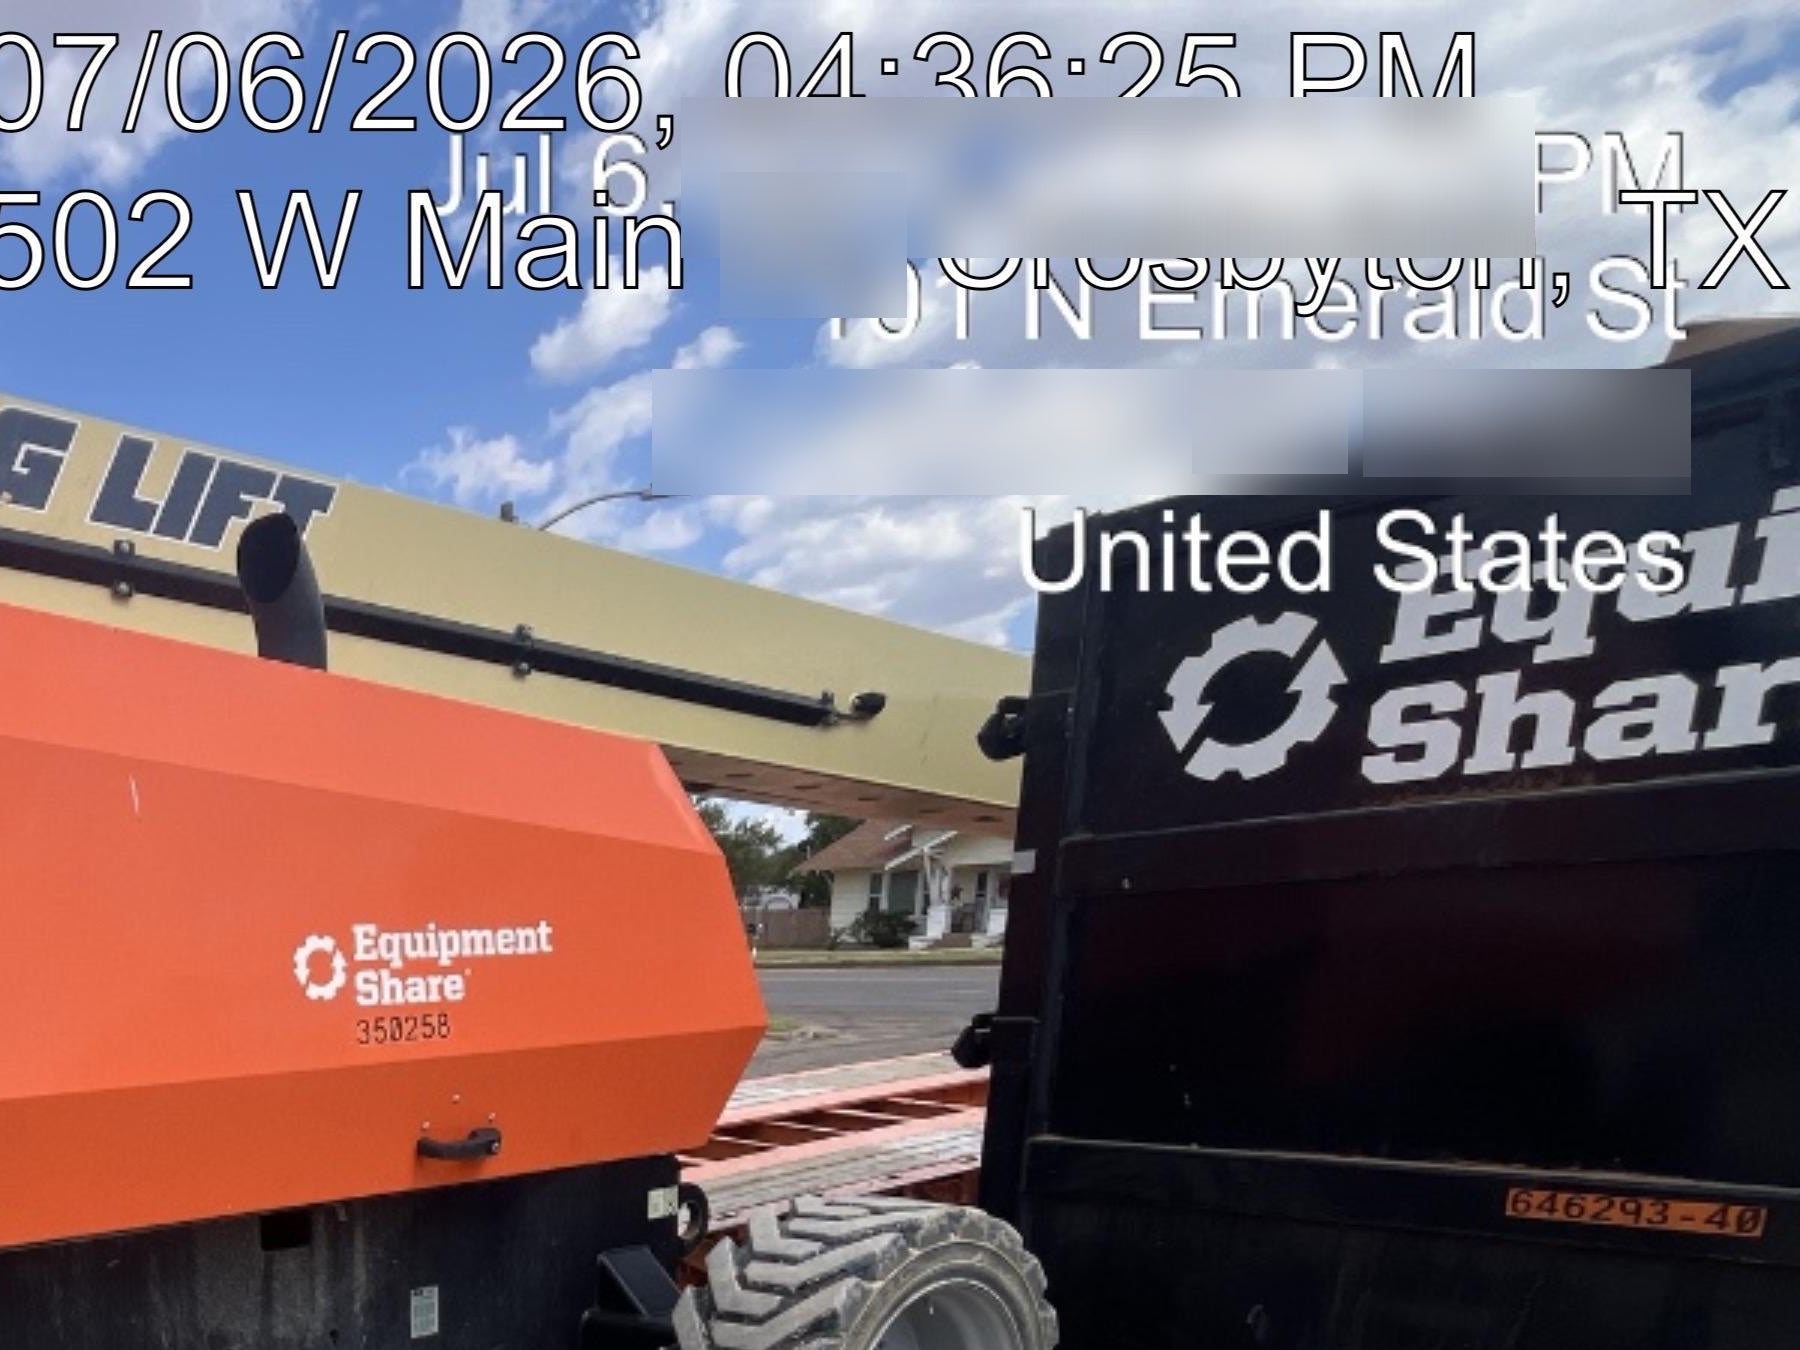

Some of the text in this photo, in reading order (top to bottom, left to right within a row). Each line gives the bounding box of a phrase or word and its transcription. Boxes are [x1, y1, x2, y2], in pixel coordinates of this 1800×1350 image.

[352, 920, 553, 968] Equipment
[354, 968, 466, 1006] Share
[356, 1013, 451, 1045] 350258
[1510, 1191, 1761, 1234] 646293-40
